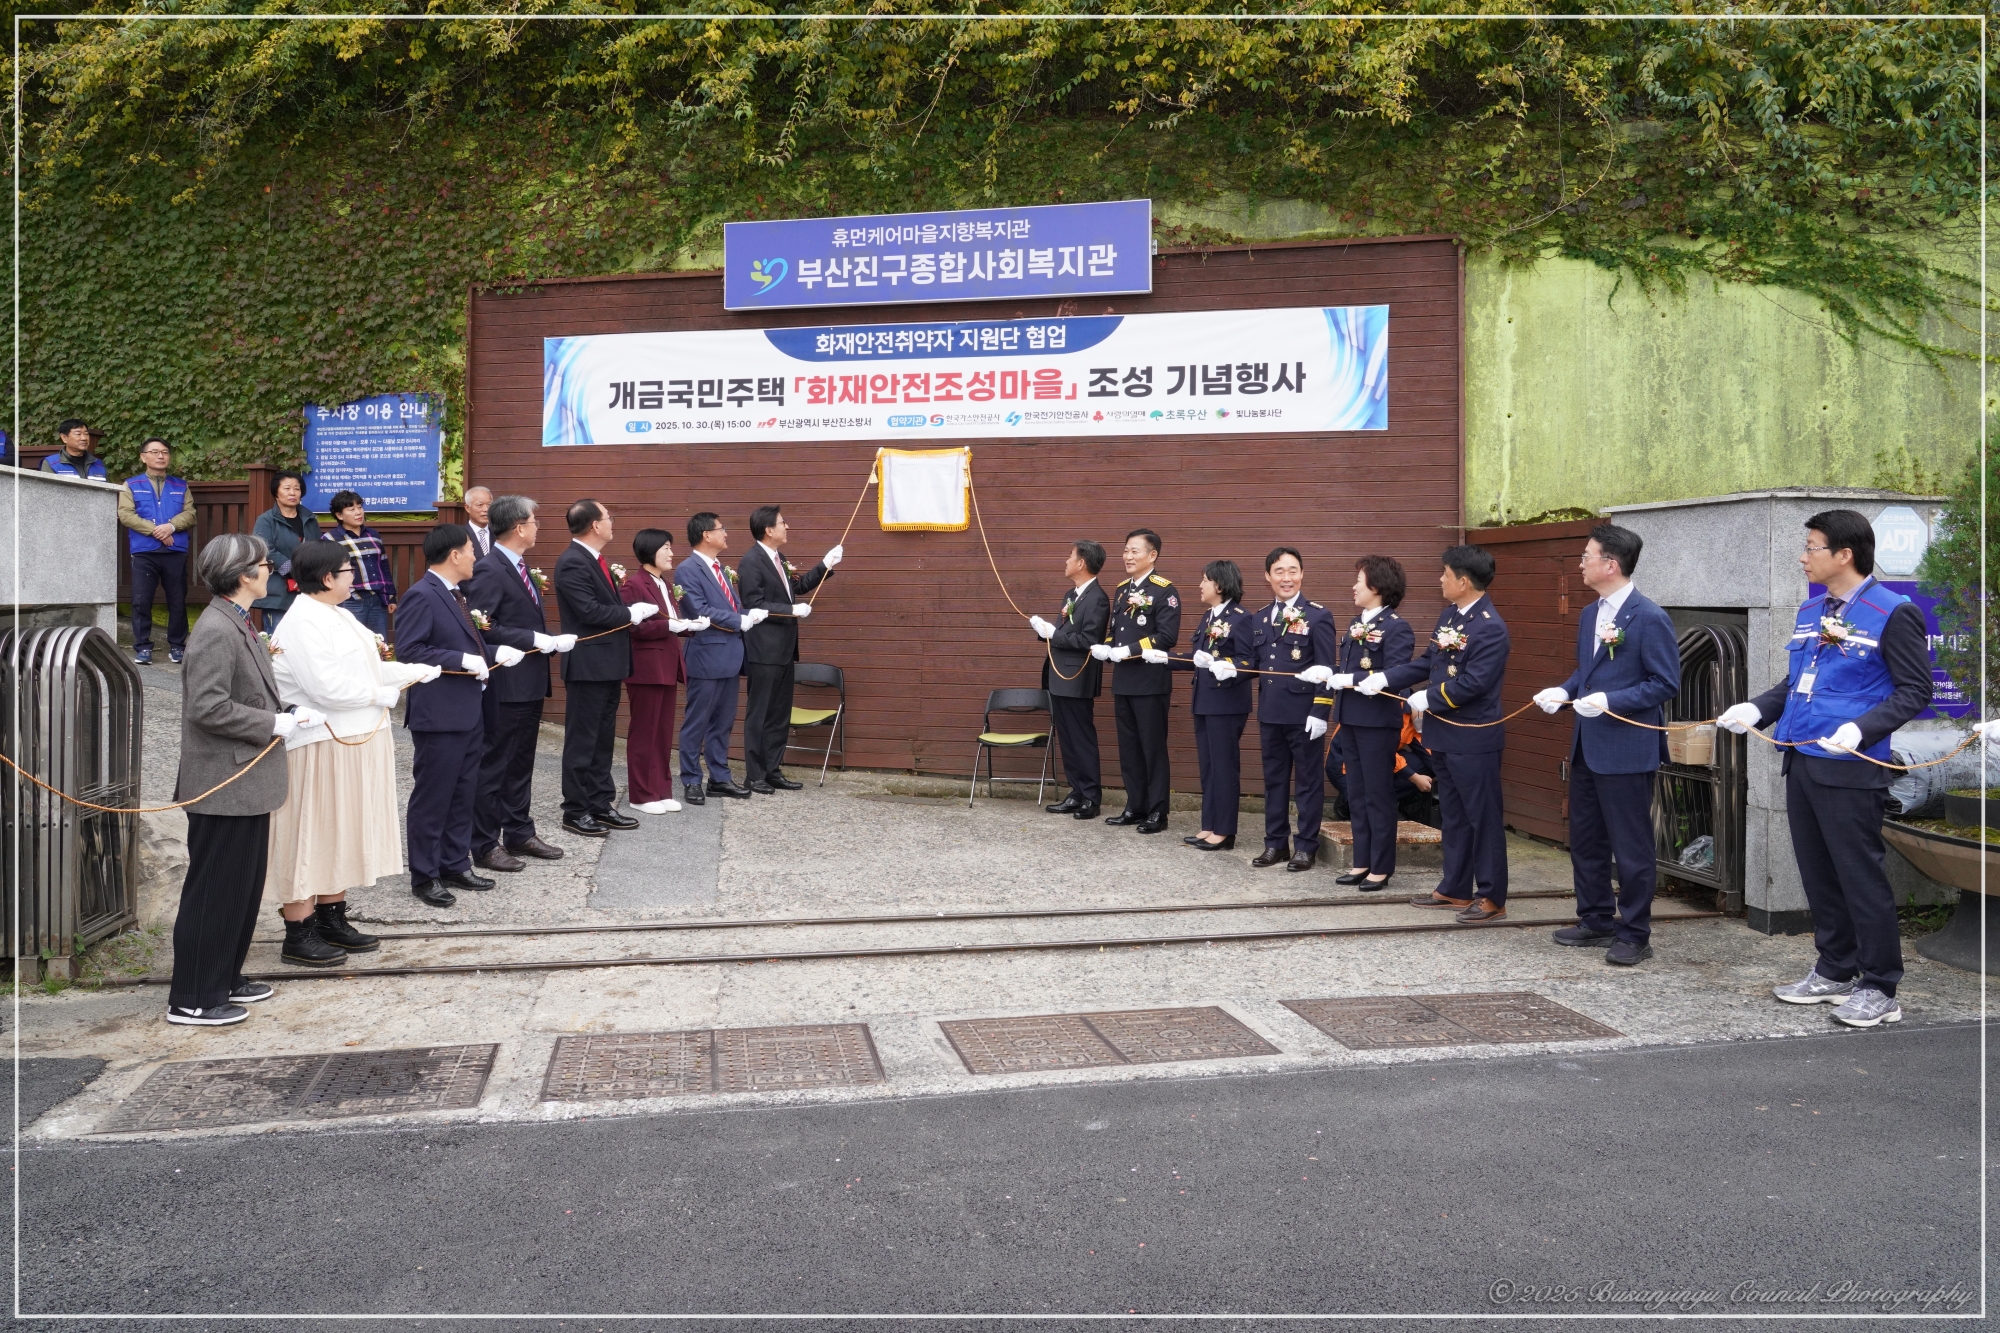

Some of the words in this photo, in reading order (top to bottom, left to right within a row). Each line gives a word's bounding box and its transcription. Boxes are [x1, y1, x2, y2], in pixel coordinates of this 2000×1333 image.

[832, 219, 1030, 248] 휴먼케어마을지향복지관
[797, 244, 1117, 289] 부산진구종합사회복지관
[816, 329, 954, 355] 화재안전취약자
[959, 327, 1021, 351] 지원단
[1026, 325, 1066, 349] 협업
[608, 377, 785, 410] 개금국민주택
[794, 368, 1077, 405] 「화재안전조성마을」
[1088, 365, 1153, 398] 조성
[1167, 361, 1306, 396] 기념행사
[365, 402, 394, 419] 이용
[399, 402, 428, 418] 안내
[1024, 410, 1089, 420] 한국전기안전공사
[1166, 409, 1208, 421] 초록우산
[1236, 408, 1283, 418] 빛나눔봉사단
[779, 418, 821, 429] 부산광역시
[822, 417, 872, 427] 부산진소방서
[890, 416, 925, 427] 협약기관
[946, 413, 1000, 422] 한국가스안전공사
[726, 419, 752, 429] 15:00
[1879, 529, 1919, 552] ADT
